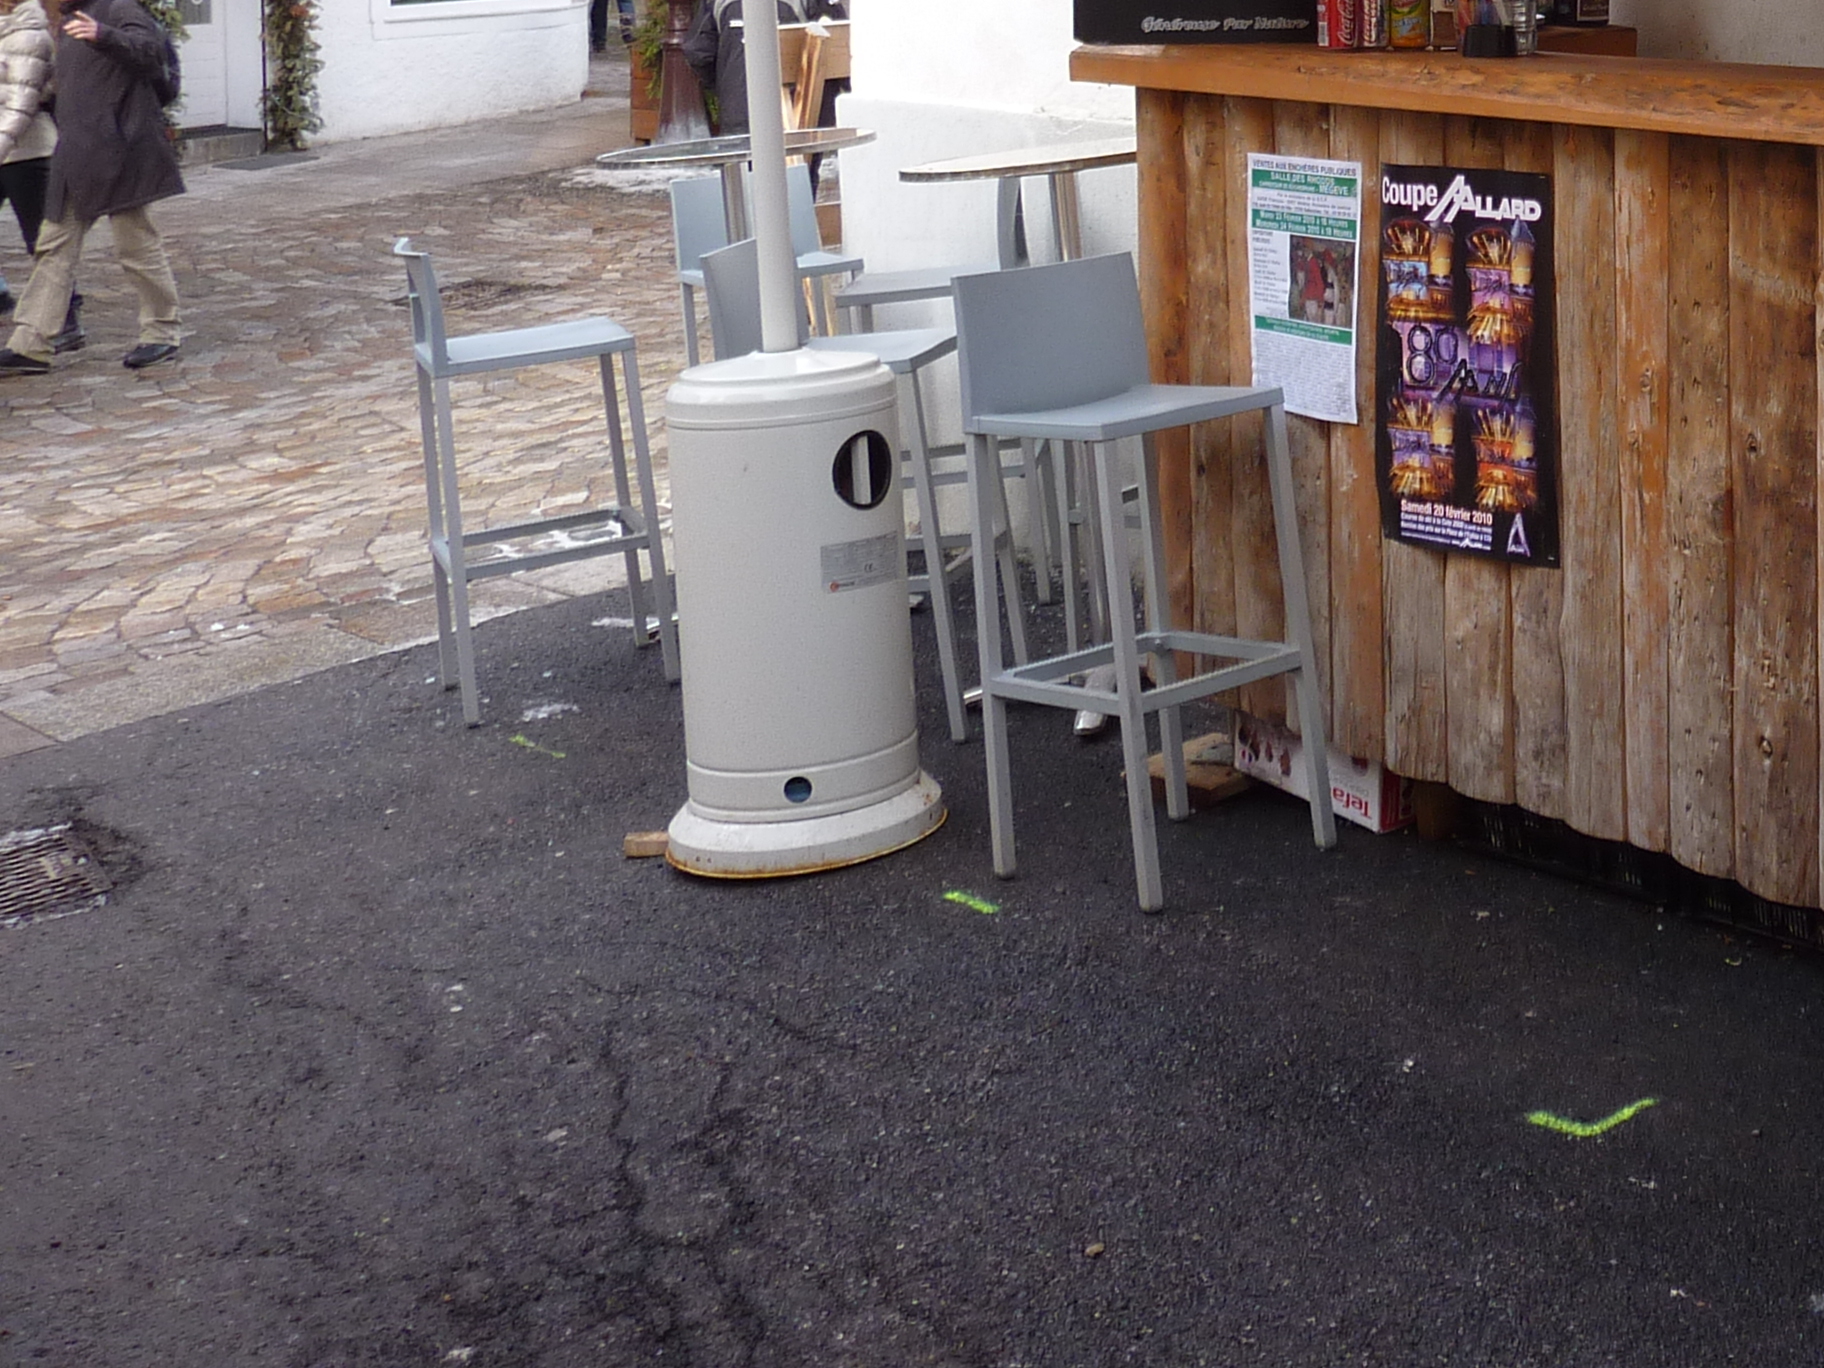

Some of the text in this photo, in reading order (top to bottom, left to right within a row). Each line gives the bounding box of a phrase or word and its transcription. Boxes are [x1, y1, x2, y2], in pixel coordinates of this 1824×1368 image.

[1252, 160, 1274, 169] VENTES
[1275, 162, 1287, 170] AUX
[1320, 165, 1357, 177] PUBLIQUES
[1382, 175, 1438, 212] Coupe
[1400, 499, 1493, 526] Samedi 20 février 2010
[1332, 787, 1372, 820] Tefa
